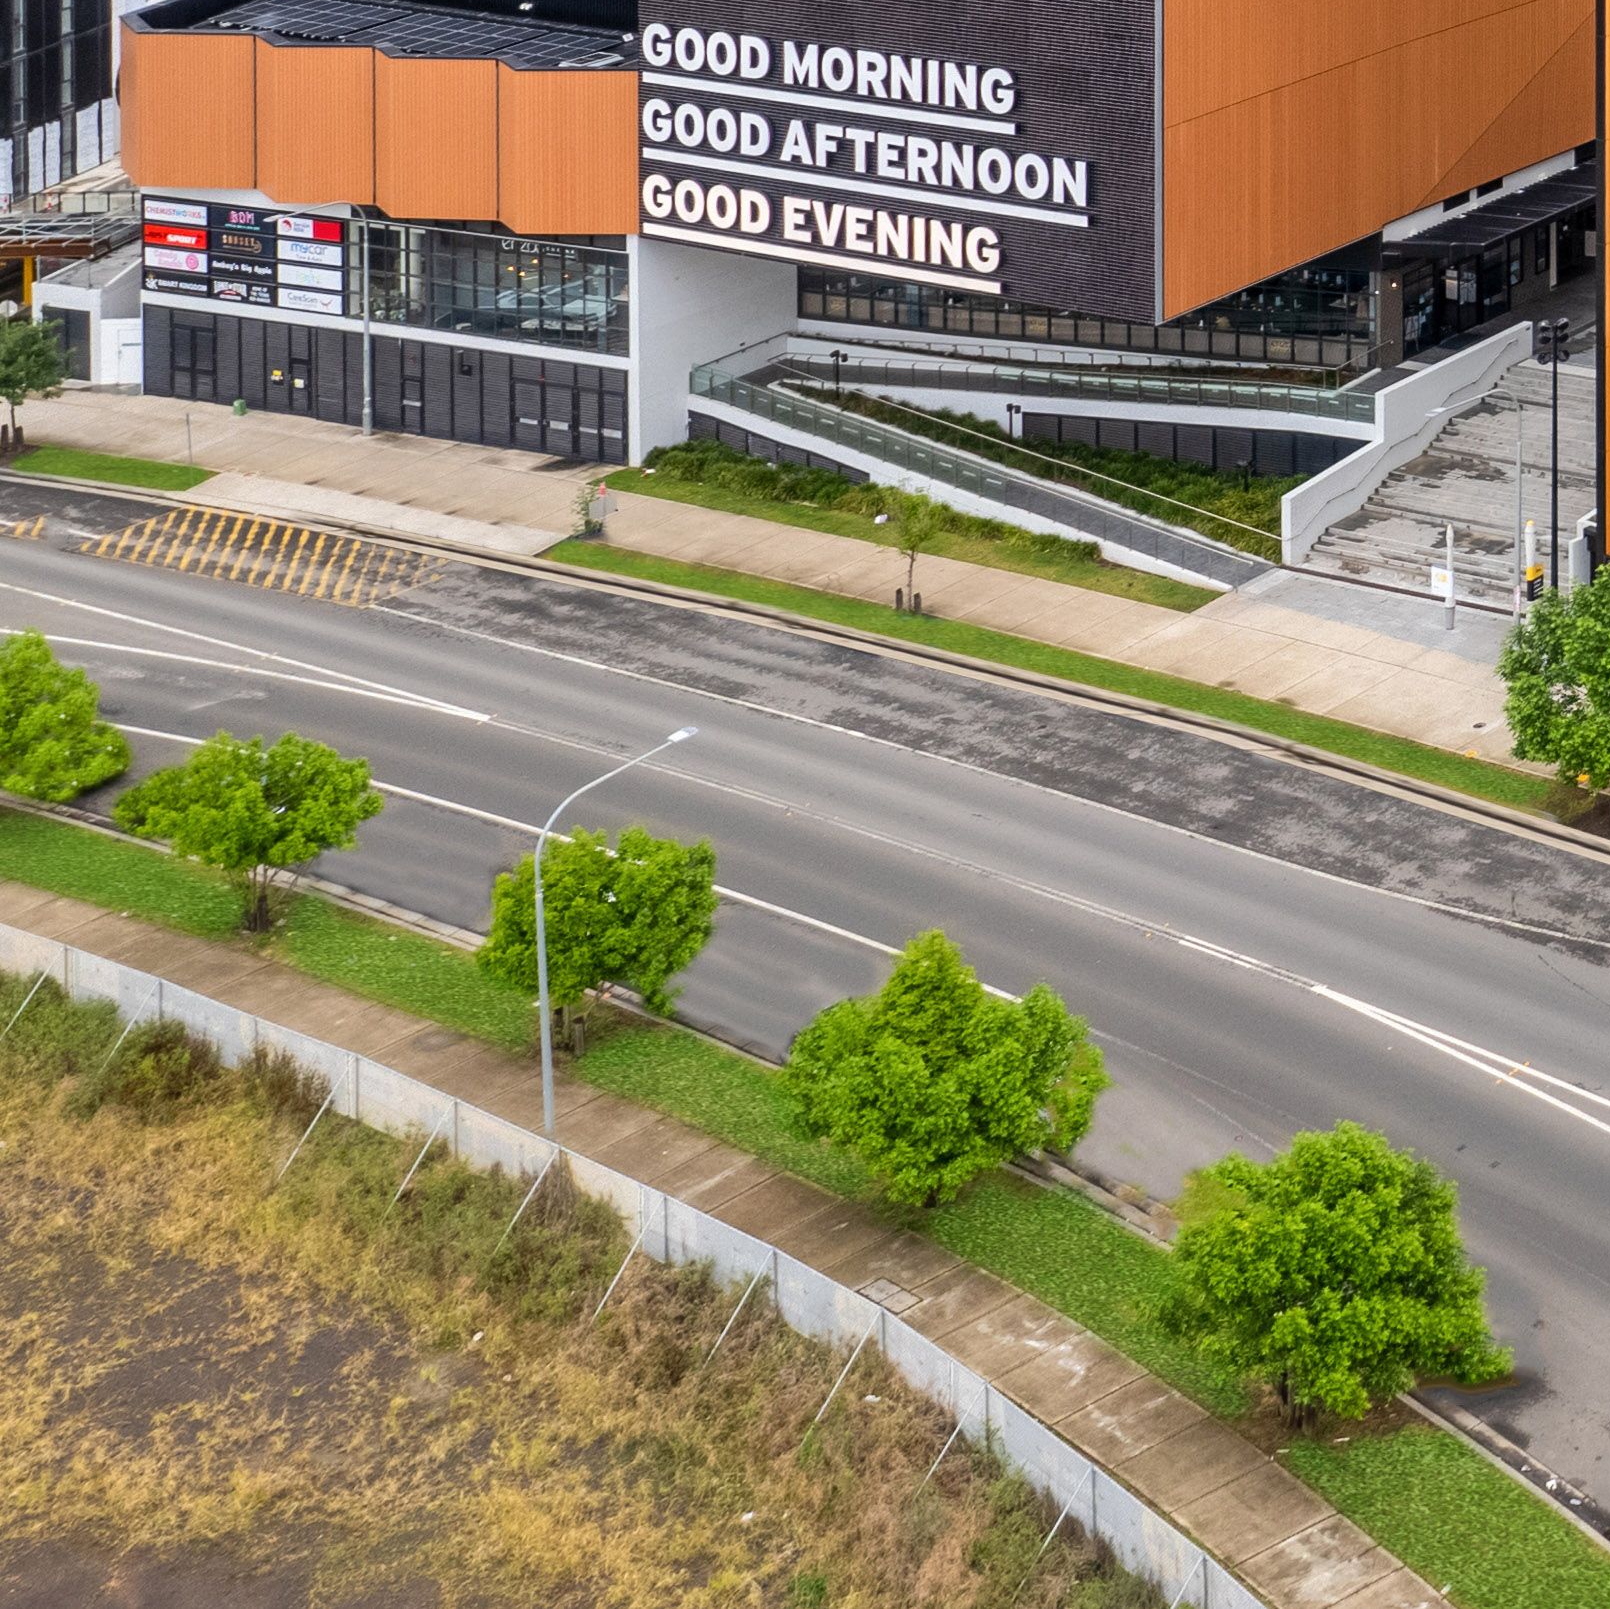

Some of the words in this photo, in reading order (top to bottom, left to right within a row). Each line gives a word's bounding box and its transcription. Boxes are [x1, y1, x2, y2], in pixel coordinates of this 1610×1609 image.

[642, 23, 770, 80] GOOD
[783, 40, 1016, 114] MORNING
[642, 98, 770, 156] GOOD
[779, 119, 1088, 207] AFTERNOON
[290, 242, 328, 256] mycar
[642, 174, 770, 234] GOOD
[783, 196, 1001, 273] EVENING
